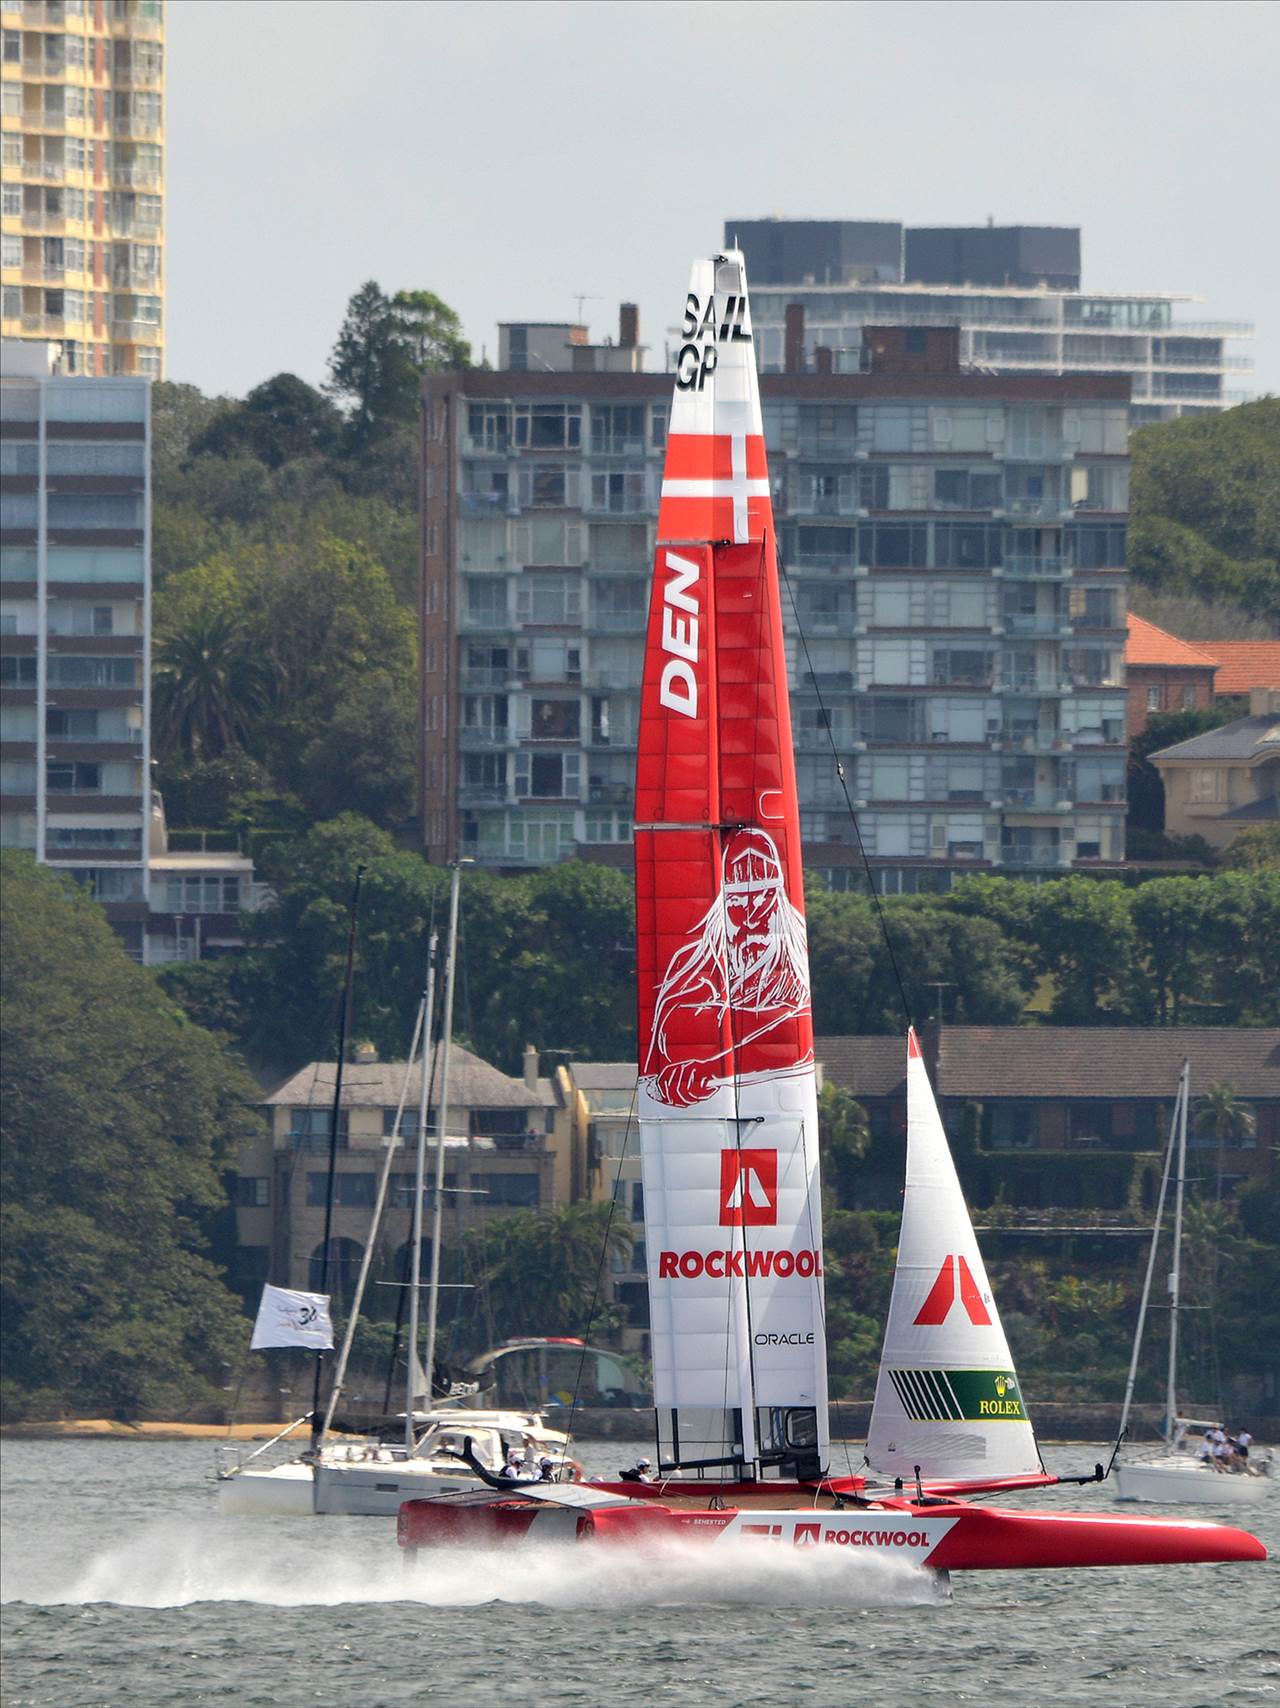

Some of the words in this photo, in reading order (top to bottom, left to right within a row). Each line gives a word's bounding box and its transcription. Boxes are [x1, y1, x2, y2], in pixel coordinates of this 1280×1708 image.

[682, 293, 752, 343] SAIL
[676, 344, 718, 392] GP
[660, 552, 700, 720] DEN
[659, 1249, 822, 1278] ROCKWOOL
[754, 1332, 815, 1346] ORACLE
[979, 1400, 1021, 1415] ROLEX
[824, 1529, 930, 1548] ROCKWOOL
